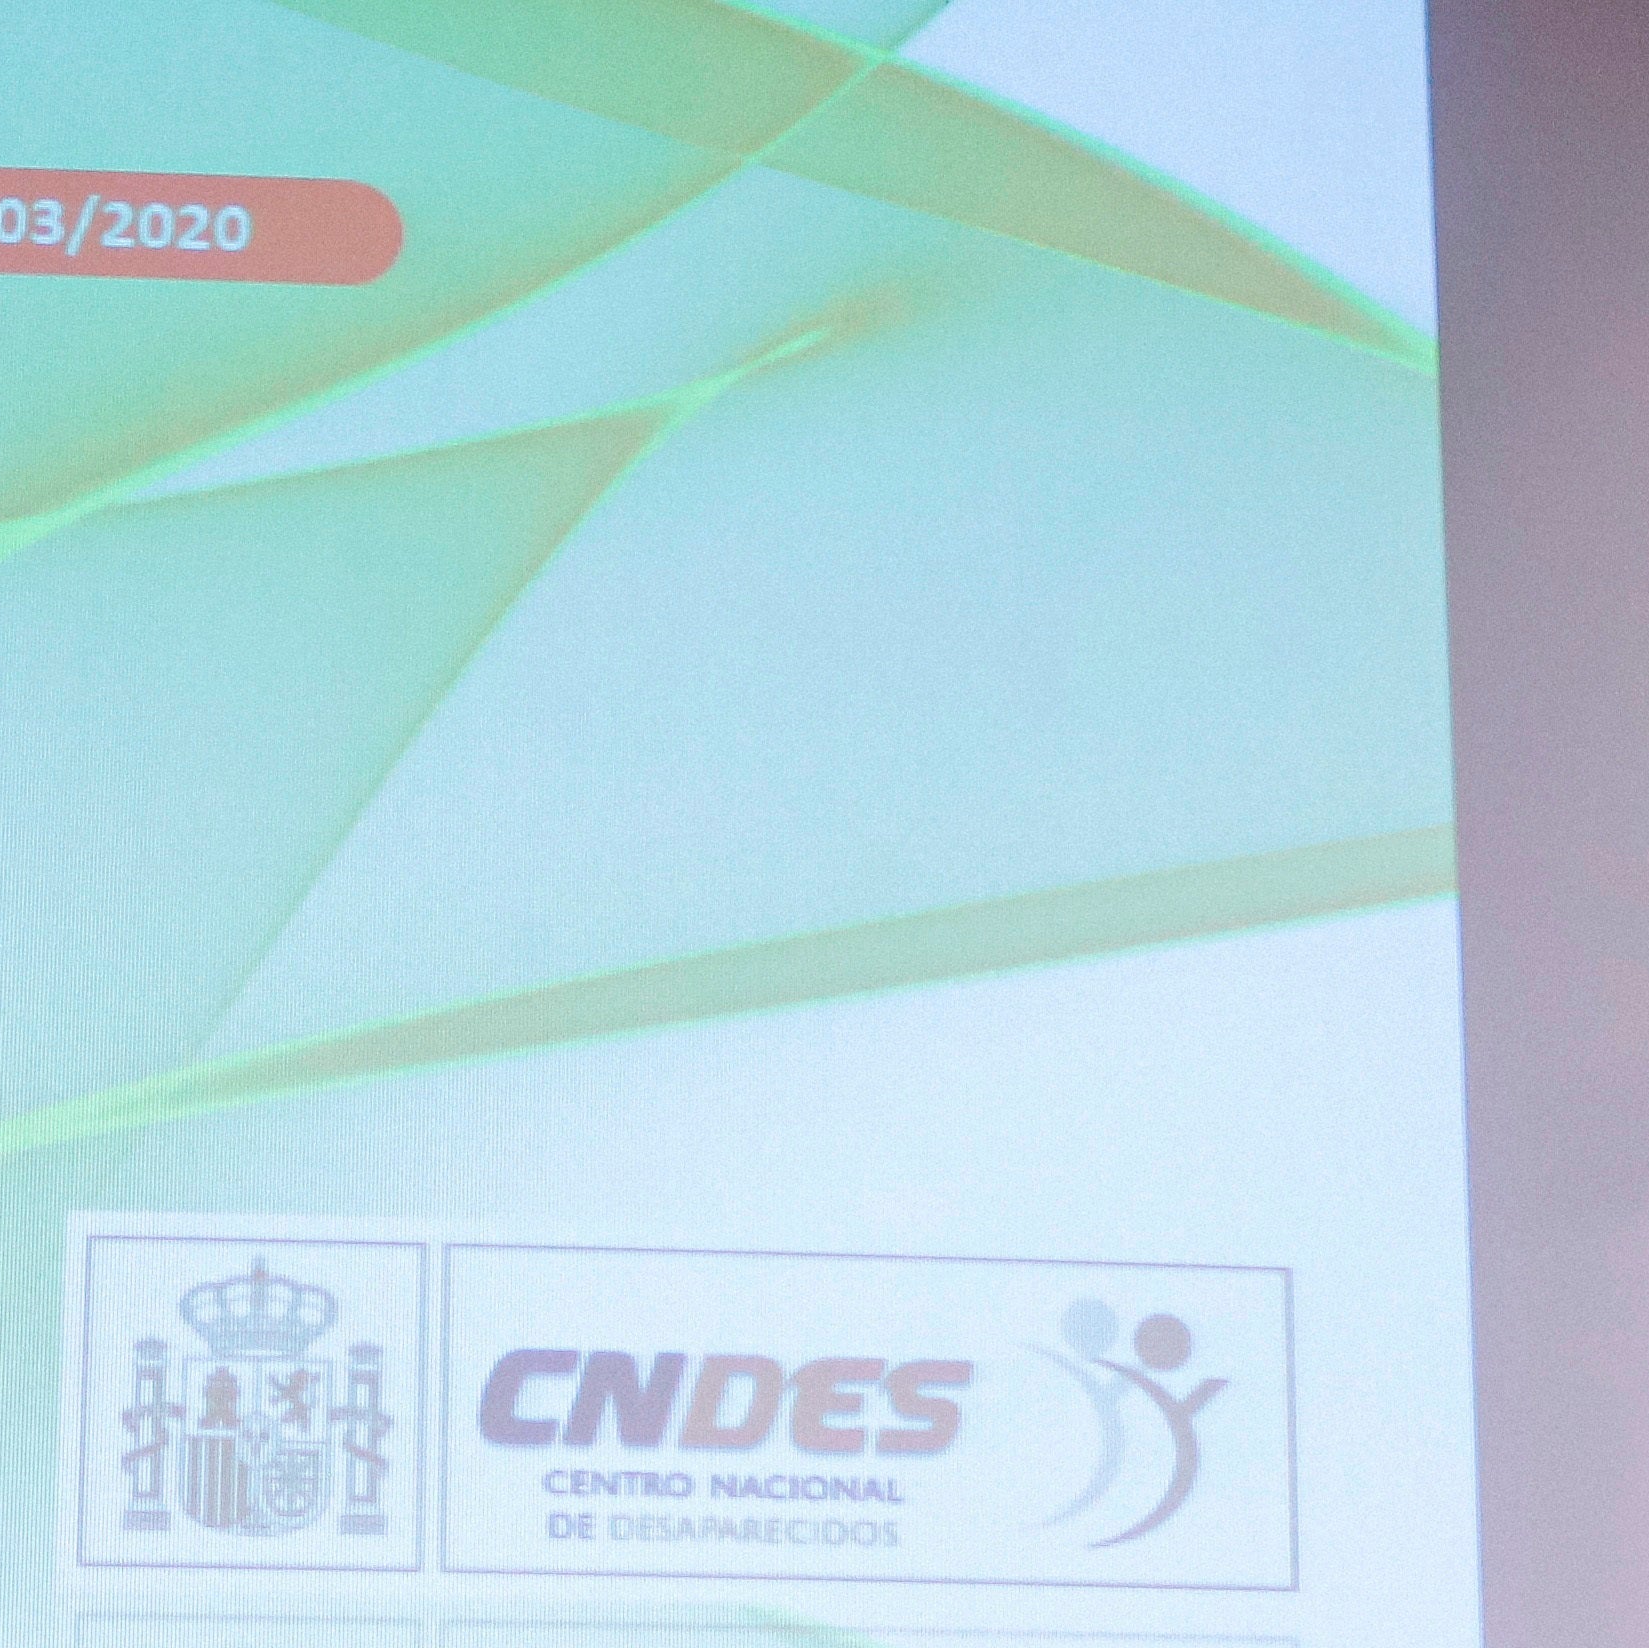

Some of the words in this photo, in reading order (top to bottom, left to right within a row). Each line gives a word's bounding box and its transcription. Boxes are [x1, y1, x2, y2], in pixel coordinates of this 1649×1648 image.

[480, 1348, 975, 1457] CNDES
[542, 1468, 696, 1501] CENTRO
[709, 1472, 905, 1506] NACIONAL
[546, 1511, 596, 1542] DE
[607, 1513, 902, 1548] DESAPARECIDOS
